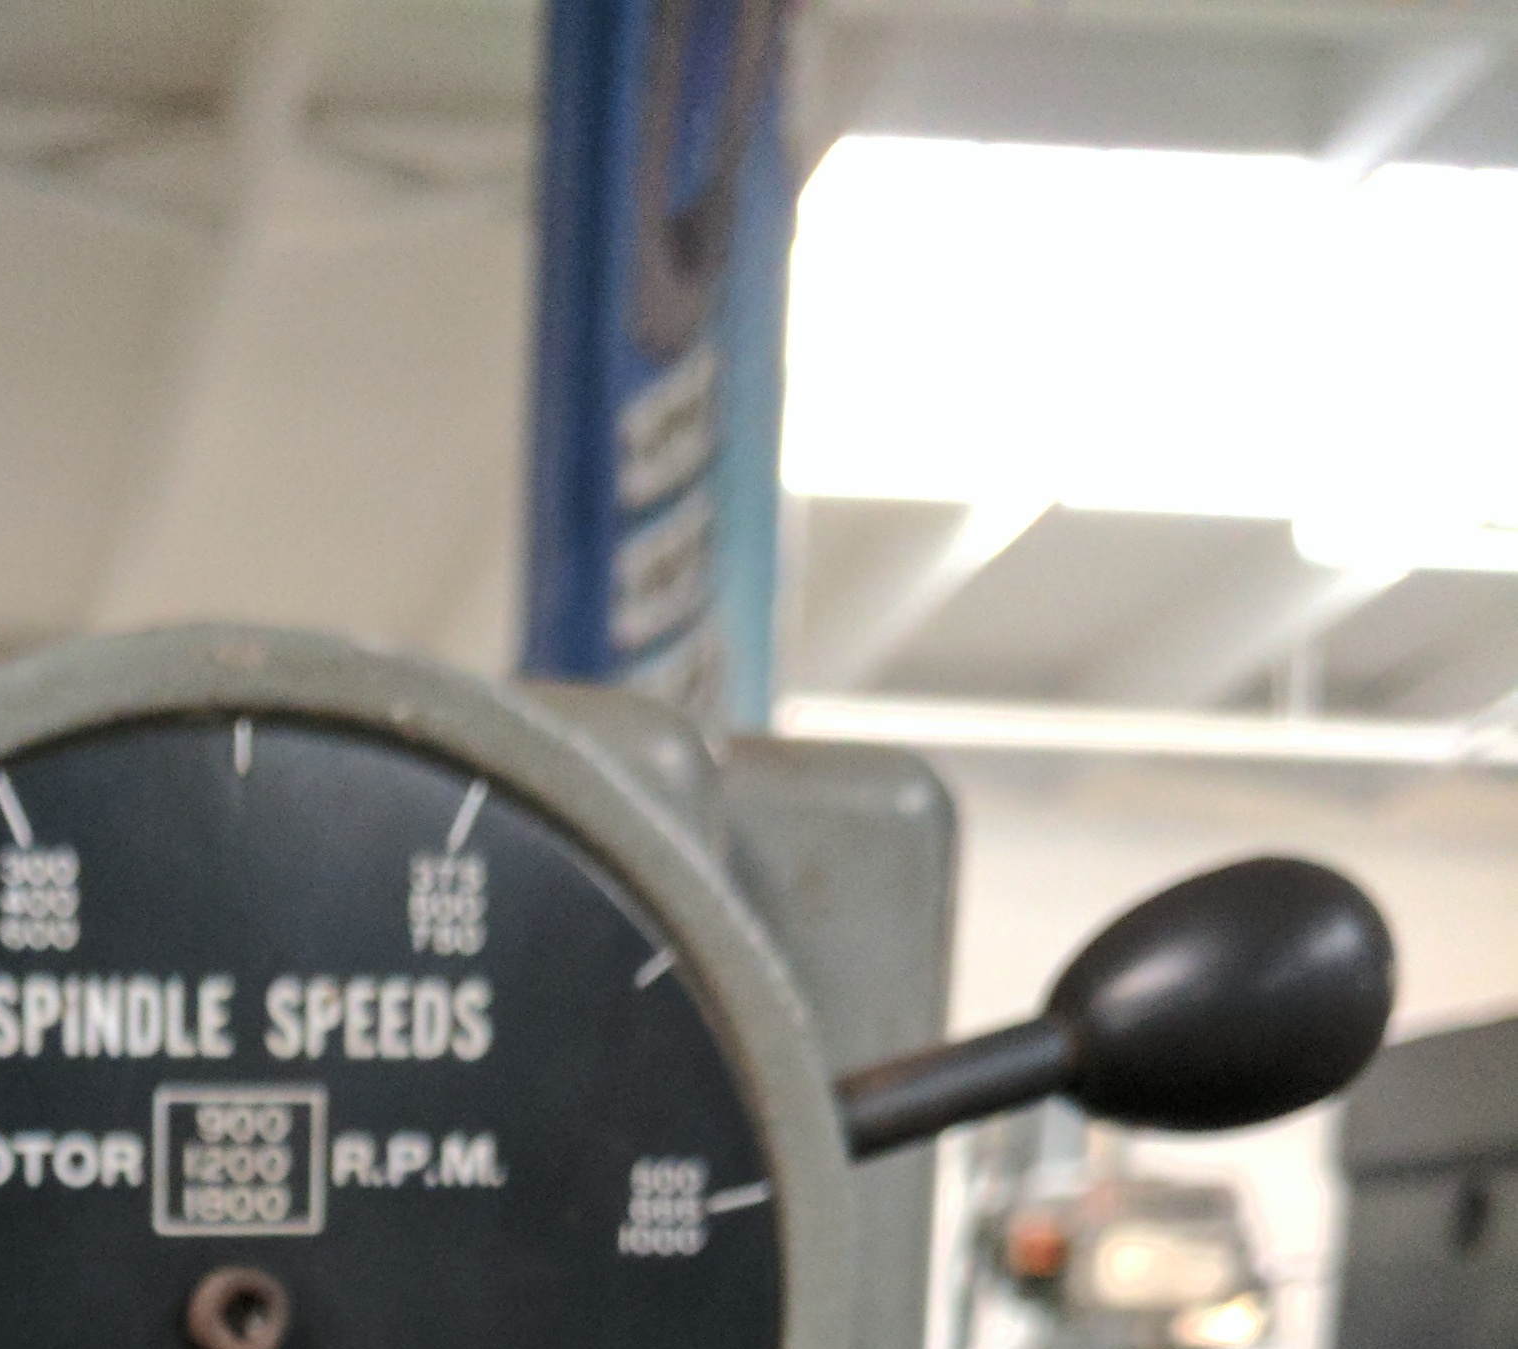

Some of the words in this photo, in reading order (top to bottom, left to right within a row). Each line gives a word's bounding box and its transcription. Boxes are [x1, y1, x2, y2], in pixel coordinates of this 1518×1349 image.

[265, 974, 493, 1061] SPEEDS
[195, 1105, 292, 1143] 900
[183, 1144, 292, 1182] 1200
[332, 1130, 505, 1188] R.P.M.
[183, 1184, 292, 1222] 1800
